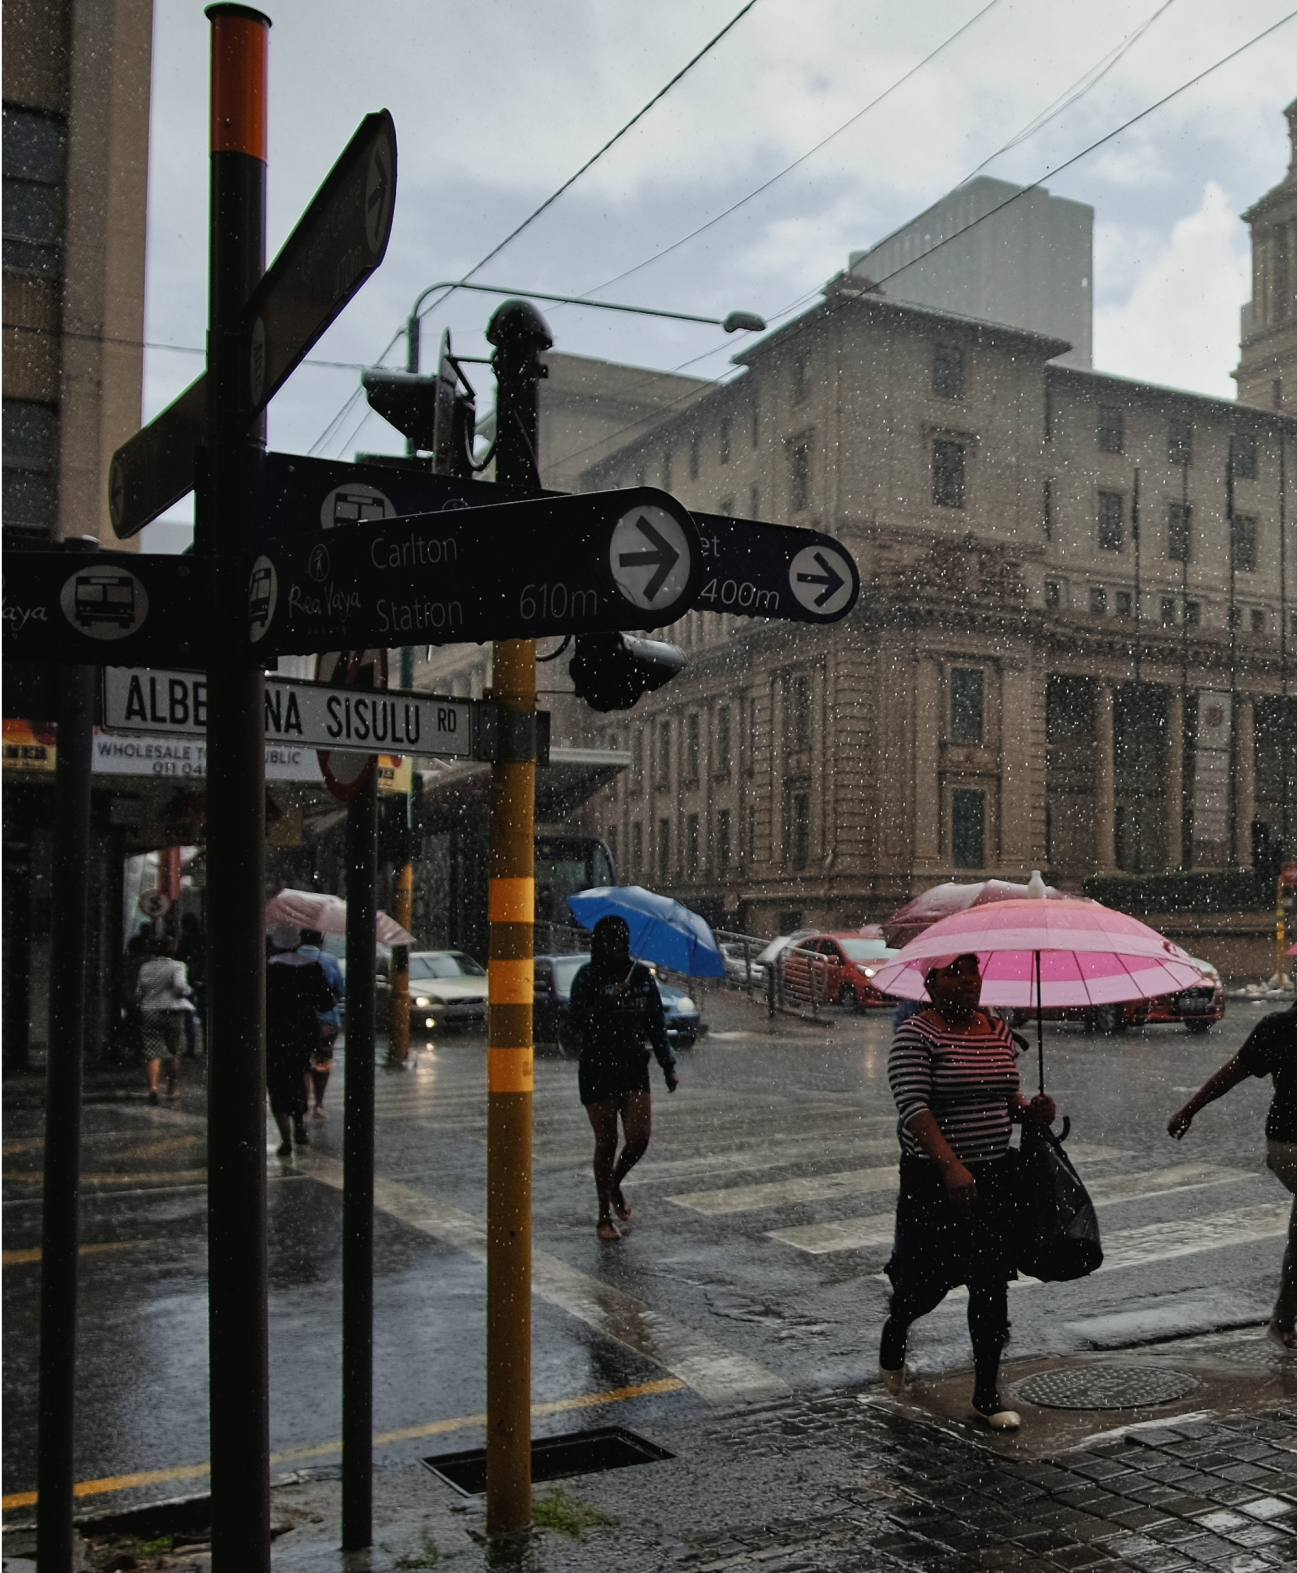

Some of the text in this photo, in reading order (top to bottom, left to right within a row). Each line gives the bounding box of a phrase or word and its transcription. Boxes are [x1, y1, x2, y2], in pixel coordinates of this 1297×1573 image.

[370, 533, 458, 569] Carlton
[699, 535, 721, 558] et
[288, 581, 361, 622] Rea Vaya
[519, 583, 598, 620] 610m
[700, 578, 780, 610] 400m
[376, 597, 463, 633] Station
[125, 675, 456, 744] ALBENA SISULU RD
[97, 742, 191, 760] WHOLESALE
[152, 761, 207, 776] 011 04
